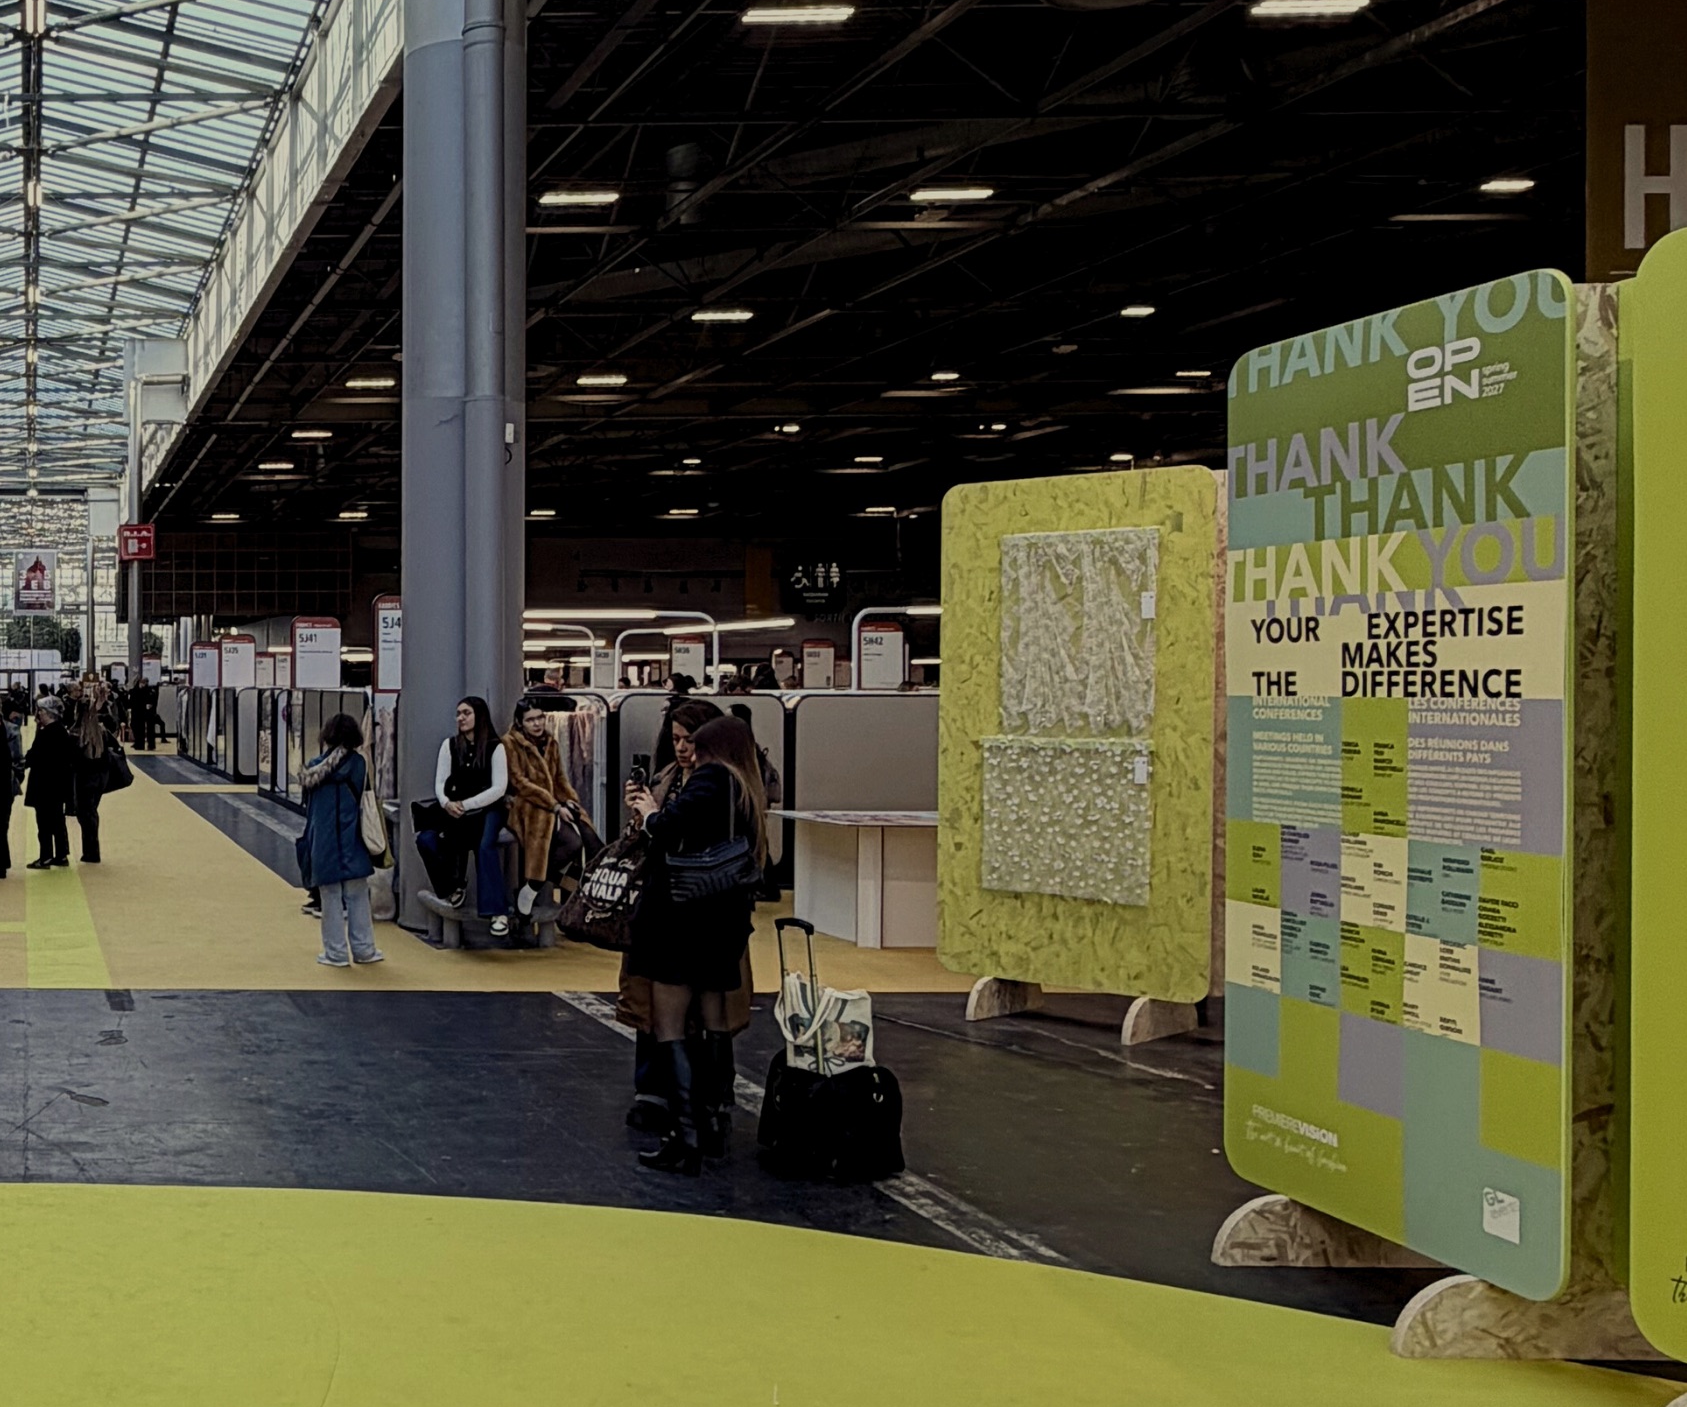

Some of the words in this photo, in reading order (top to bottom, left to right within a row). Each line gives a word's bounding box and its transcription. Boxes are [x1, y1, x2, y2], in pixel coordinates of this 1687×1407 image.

[1406, 337, 1481, 380] OP
[1481, 362, 1510, 376] spring
[1407, 368, 1480, 412] EN
[1481, 383, 1505, 398] 2027
[1302, 451, 1531, 542] THANK
[1416, 513, 1566, 588] YOU
[1251, 616, 1320, 644] YOUR
[1367, 605, 1524, 640] EXPERTISE
[298, 633, 317, 643] 5J41
[1341, 639, 1438, 669] MAKES
[1252, 671, 1298, 697] THE
[1341, 669, 1523, 699] DIFFERENCE
[1252, 695, 1331, 708] INTERNATIONAL
[1408, 696, 1428, 709] LES
[1252, 708, 1323, 721] CONFERENCES
[1408, 711, 1522, 727] INTERNATIONALES
[1408, 737, 1426, 749] DES
[1480, 741, 1510, 753] DANS
[1465, 752, 1491, 764] PAYS
